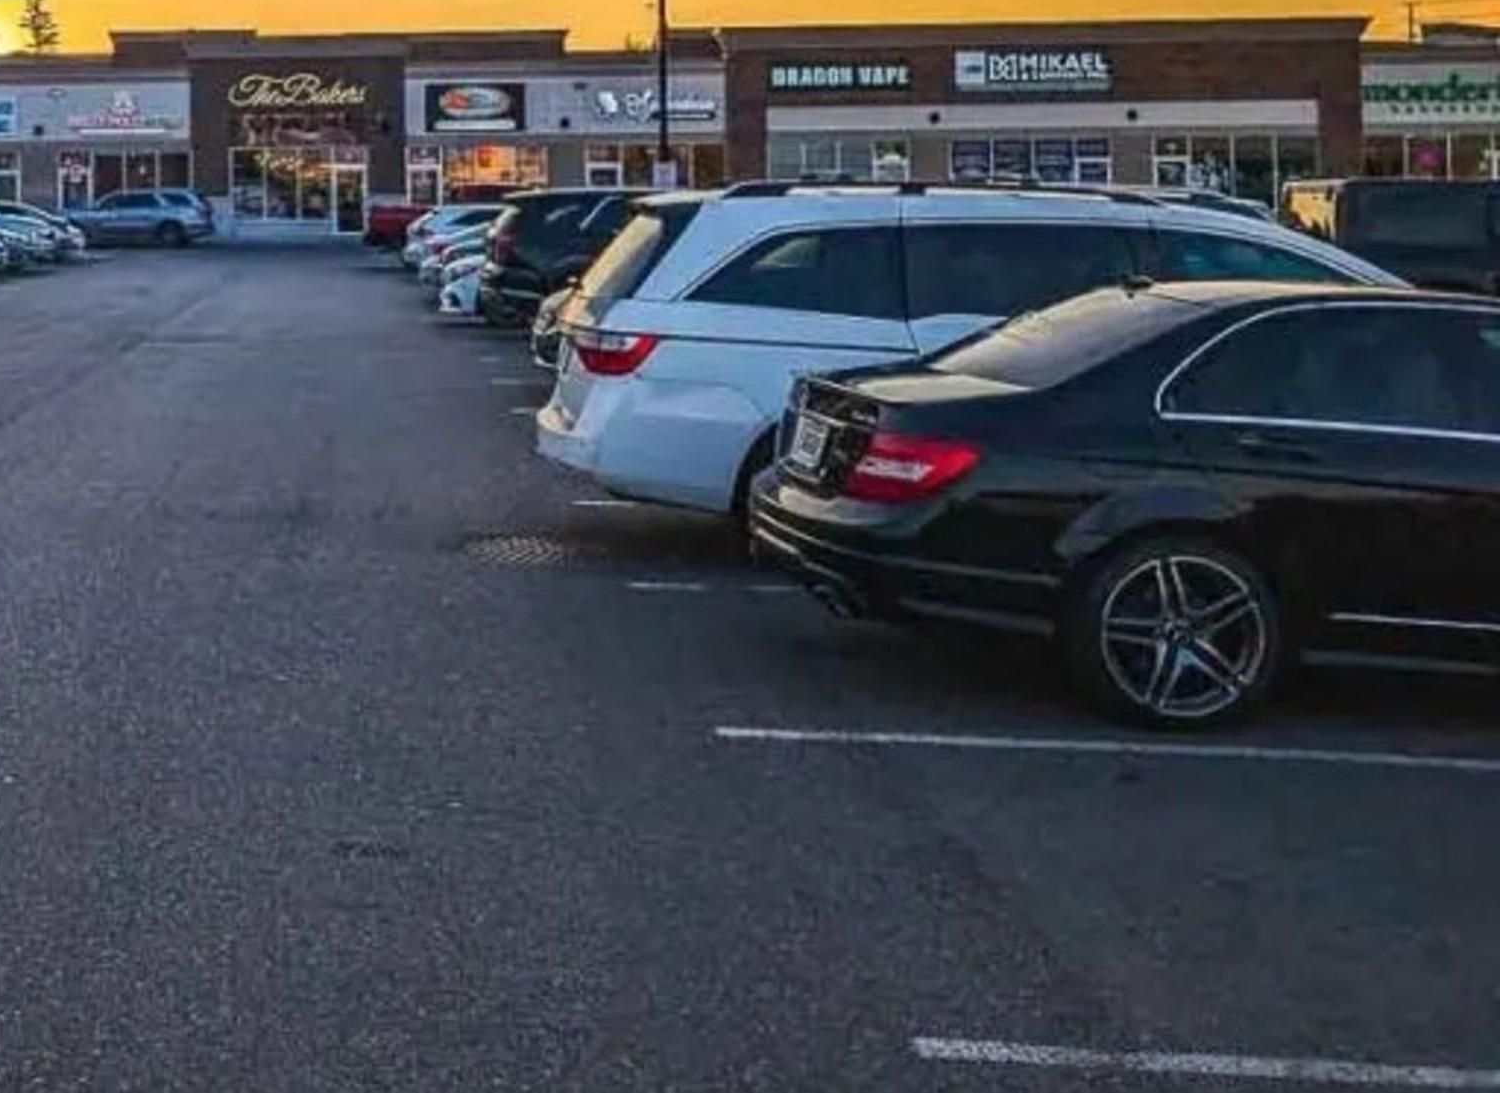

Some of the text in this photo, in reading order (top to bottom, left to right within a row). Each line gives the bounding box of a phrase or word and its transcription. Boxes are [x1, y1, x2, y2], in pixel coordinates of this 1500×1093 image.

[1019, 53, 1109, 72] MIKAEL
[771, 64, 909, 87] DRAGON VAPE
